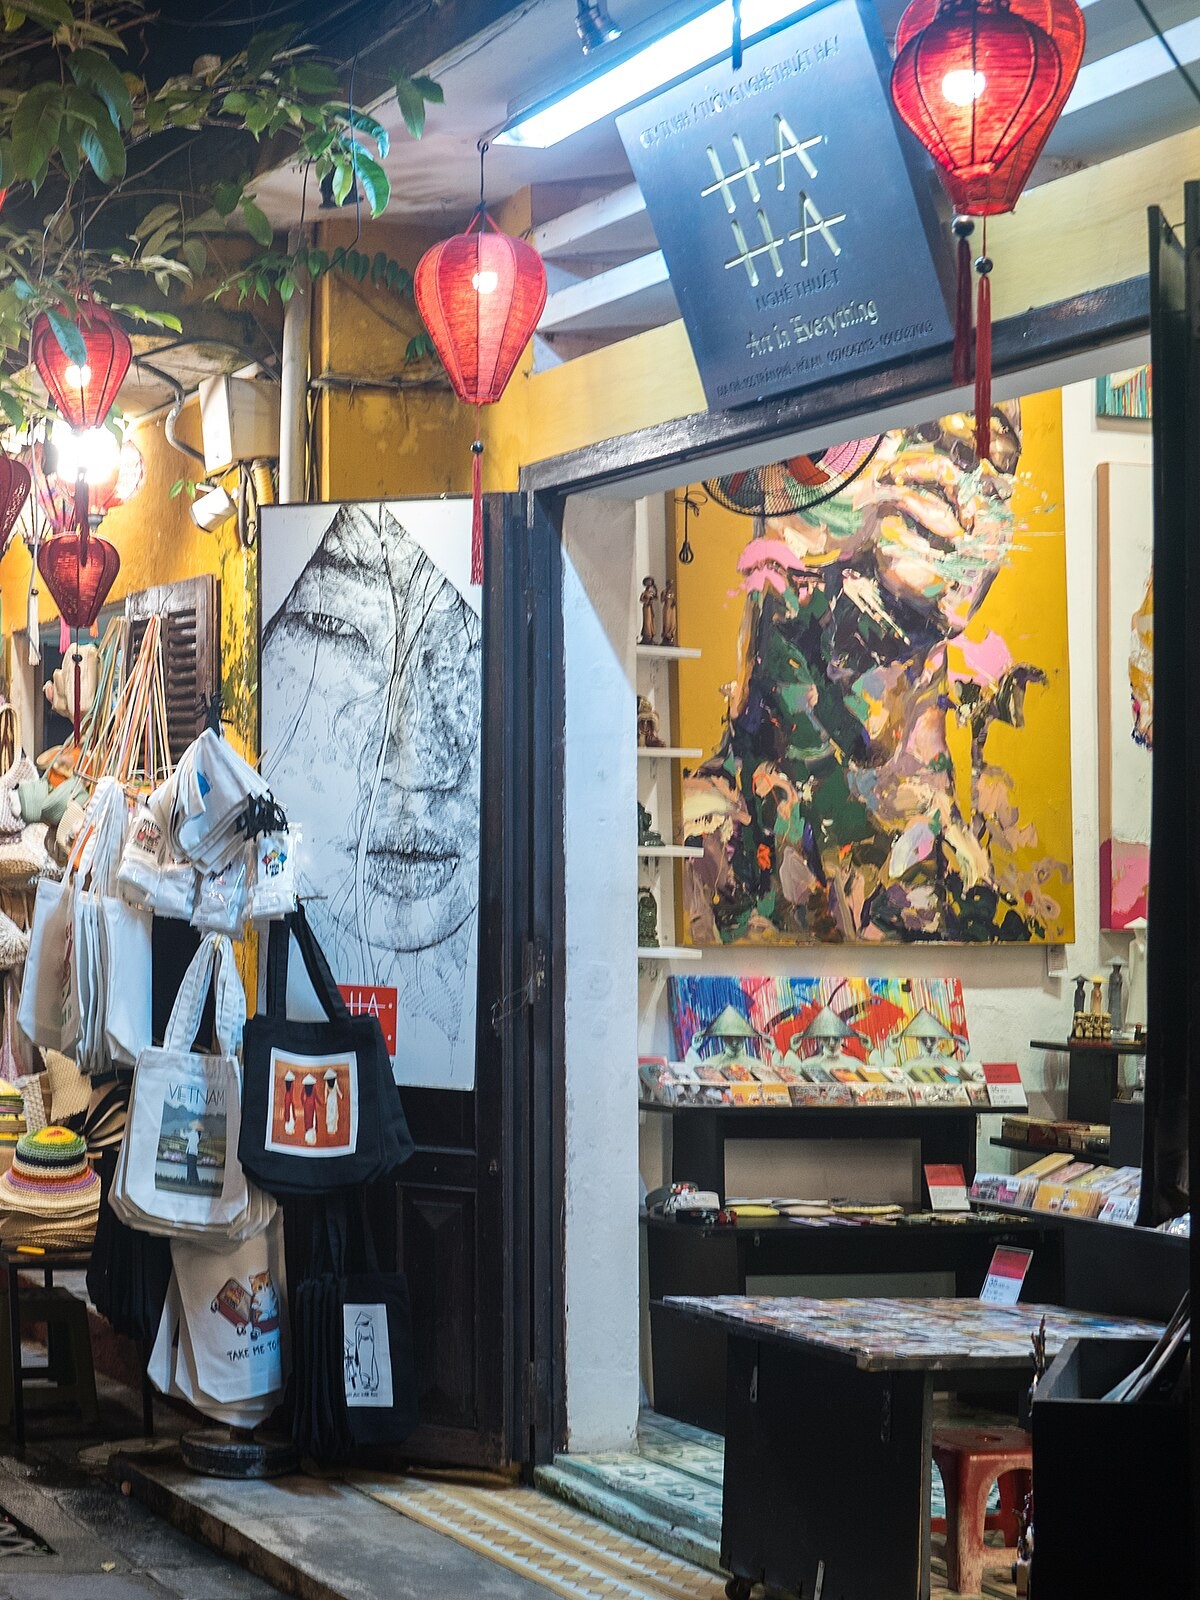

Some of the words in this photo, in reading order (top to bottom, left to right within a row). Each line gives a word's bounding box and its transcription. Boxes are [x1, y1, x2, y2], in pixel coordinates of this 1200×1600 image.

[700, 113, 823, 214] HA
[724, 190, 847, 288] HA
[774, 322, 792, 350] in
[790, 297, 880, 342] Everything
[168, 1082, 225, 1106] VIETNAM
[227, 1347, 250, 1362] TAKE
[252, 1343, 266, 1356] ME
